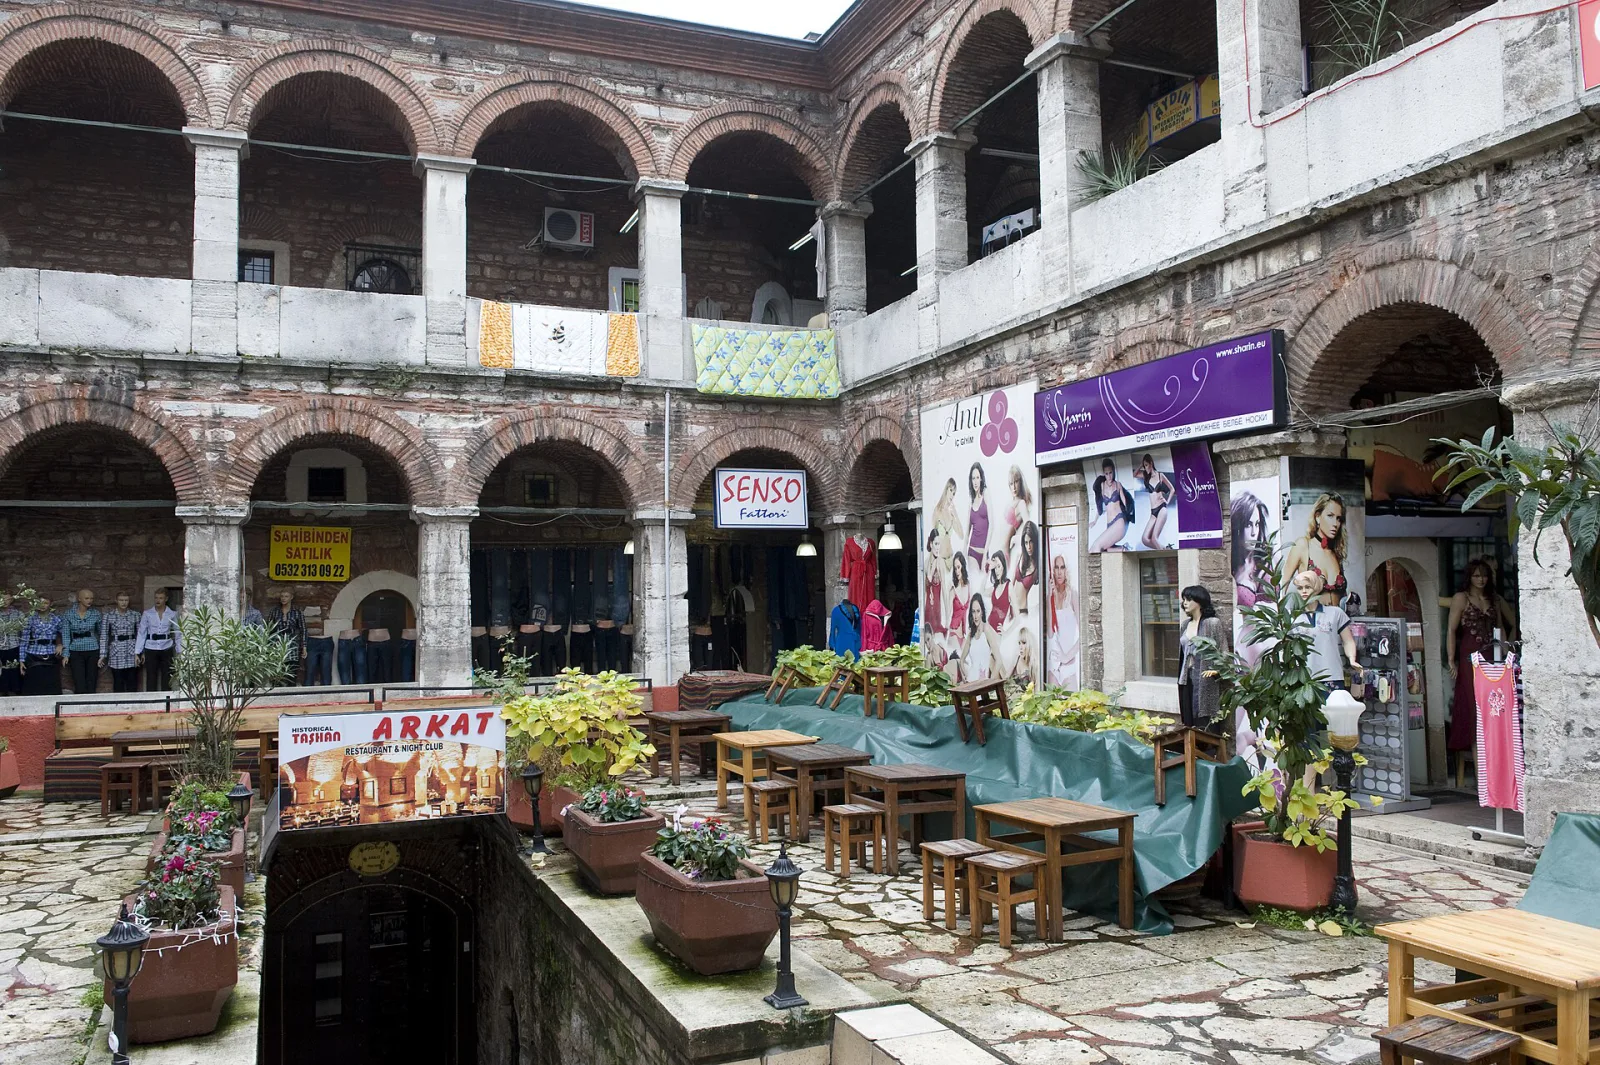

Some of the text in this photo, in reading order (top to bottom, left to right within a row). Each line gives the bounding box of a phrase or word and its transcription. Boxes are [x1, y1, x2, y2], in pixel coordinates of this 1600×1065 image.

[1156, 90, 1190, 120] AYDIN
[582, 213, 590, 242] VESTEL
[1215, 340, 1266, 358] www.sharin.eu
[1048, 389, 1092, 445] Sharin
[1194, 423, 1220, 433] НИЖНЕЕ
[1245, 413, 1268, 424] НОСКИ
[1136, 425, 1192, 443] benjamin lingerie
[722, 474, 801, 503] SENSO
[1185, 468, 1215, 503] Sharin
[739, 507, 788, 520] Fattori
[273, 528, 349, 544] SAHİBİNDEN
[286, 547, 332, 560] SATILIK
[275, 563, 345, 577] 0532 313 09 22
[372, 711, 495, 741] ARKAT
[345, 742, 444, 756] RESTAURANT & NIGHT CLUB
